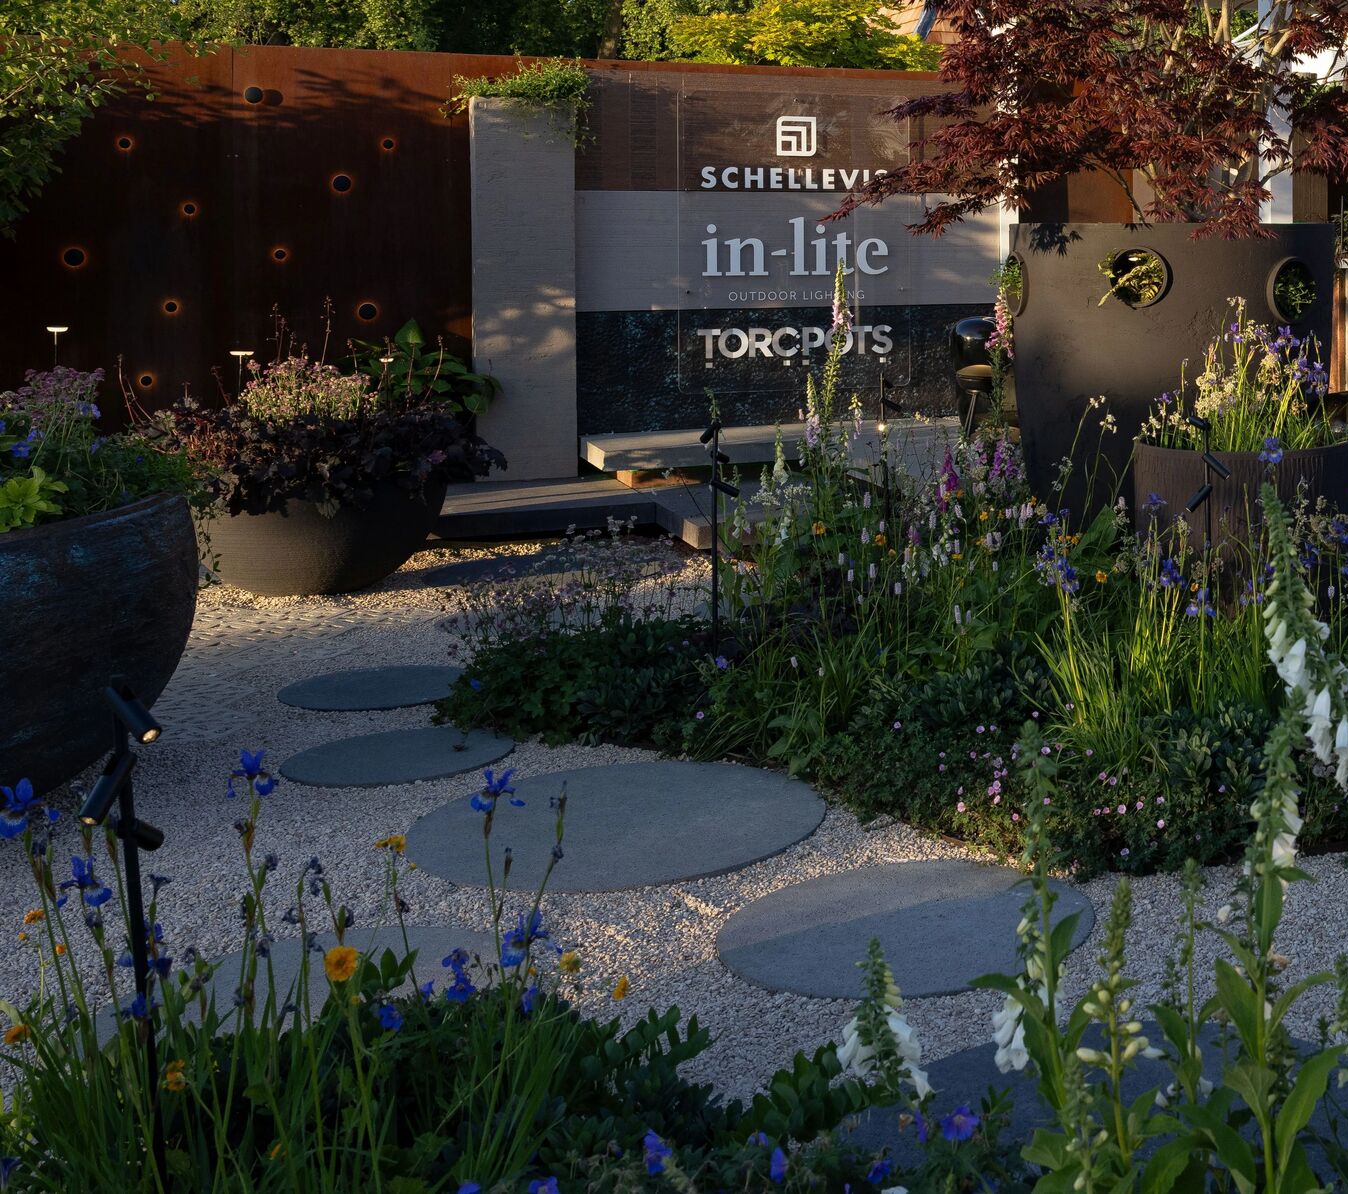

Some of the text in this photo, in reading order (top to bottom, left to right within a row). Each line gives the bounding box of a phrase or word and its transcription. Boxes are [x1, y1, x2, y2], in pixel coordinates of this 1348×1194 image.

[701, 216, 889, 277] in-lite
[728, 289, 865, 302] OUTDOOR LIGHNG
